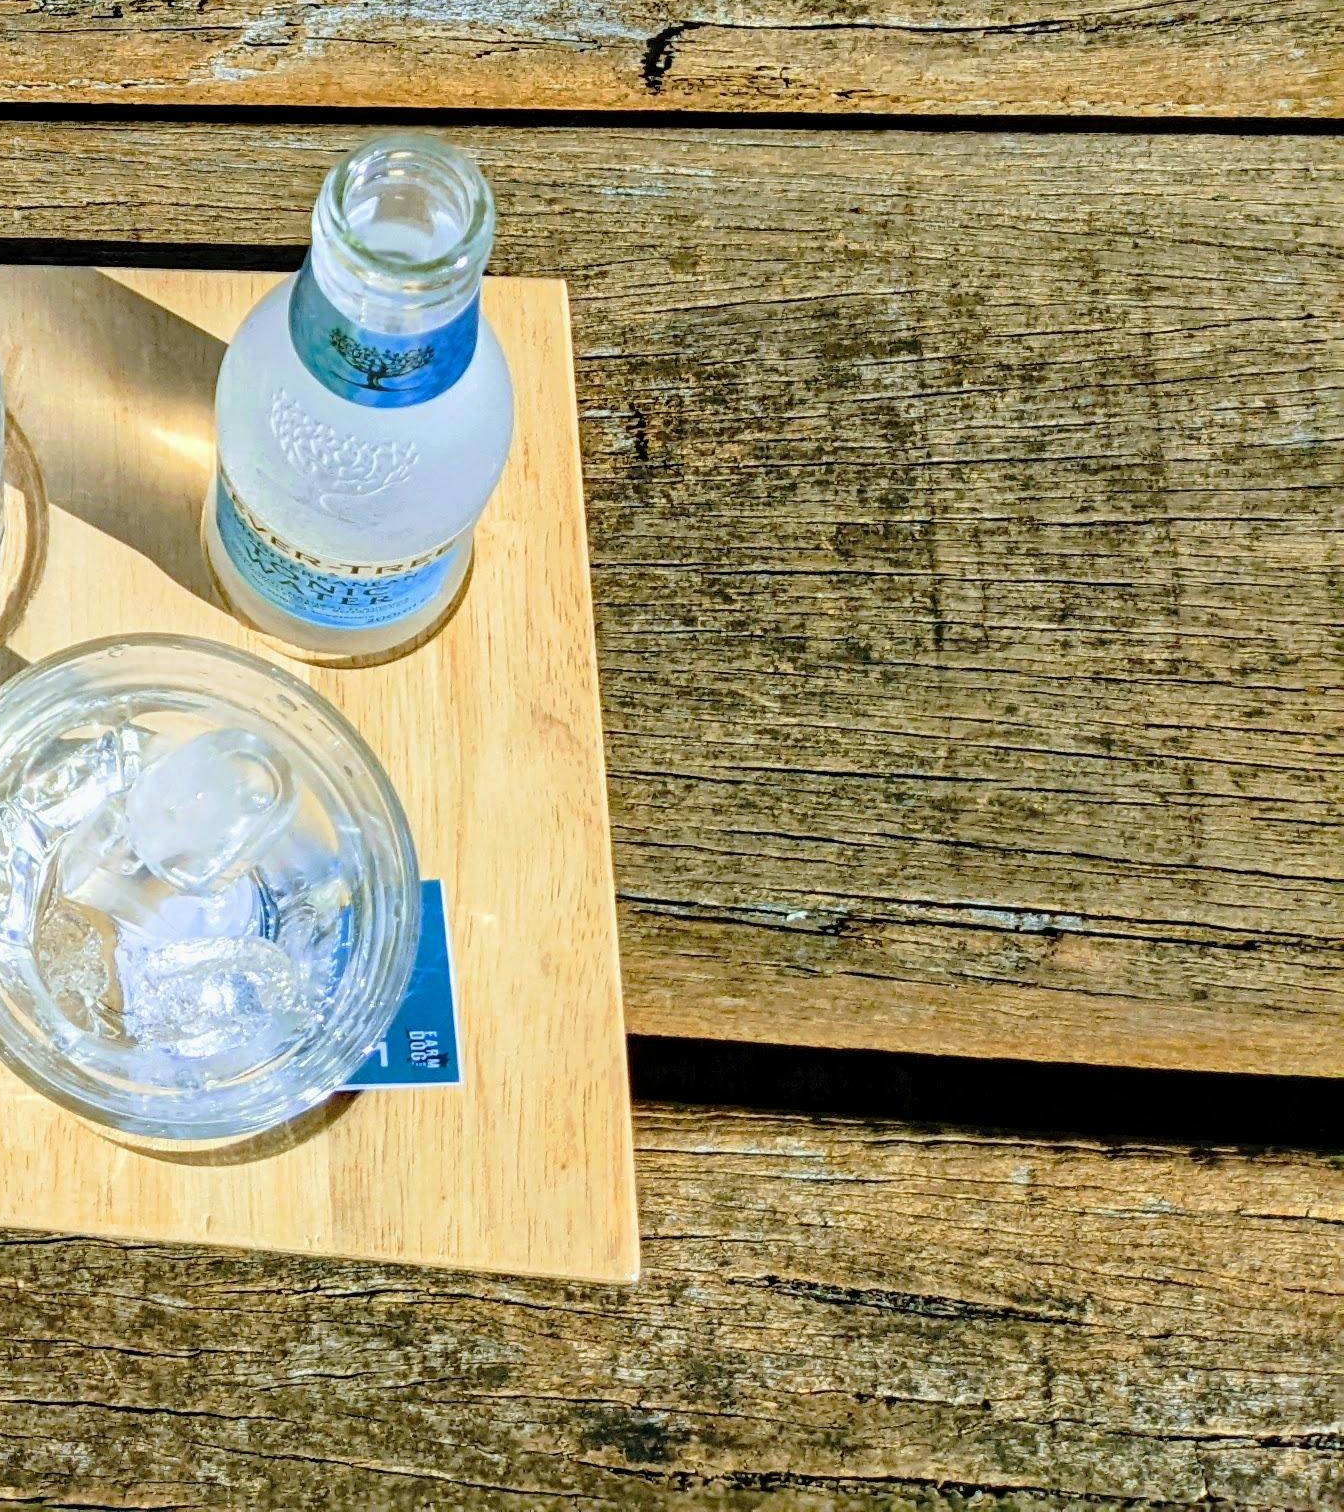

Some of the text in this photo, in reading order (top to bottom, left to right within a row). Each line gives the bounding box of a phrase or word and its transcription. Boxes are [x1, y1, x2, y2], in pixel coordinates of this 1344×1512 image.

[218, 463, 457, 576] EVER-TREE
[409, 1031, 427, 1061] DOG
[425, 1031, 440, 1068] FARM
